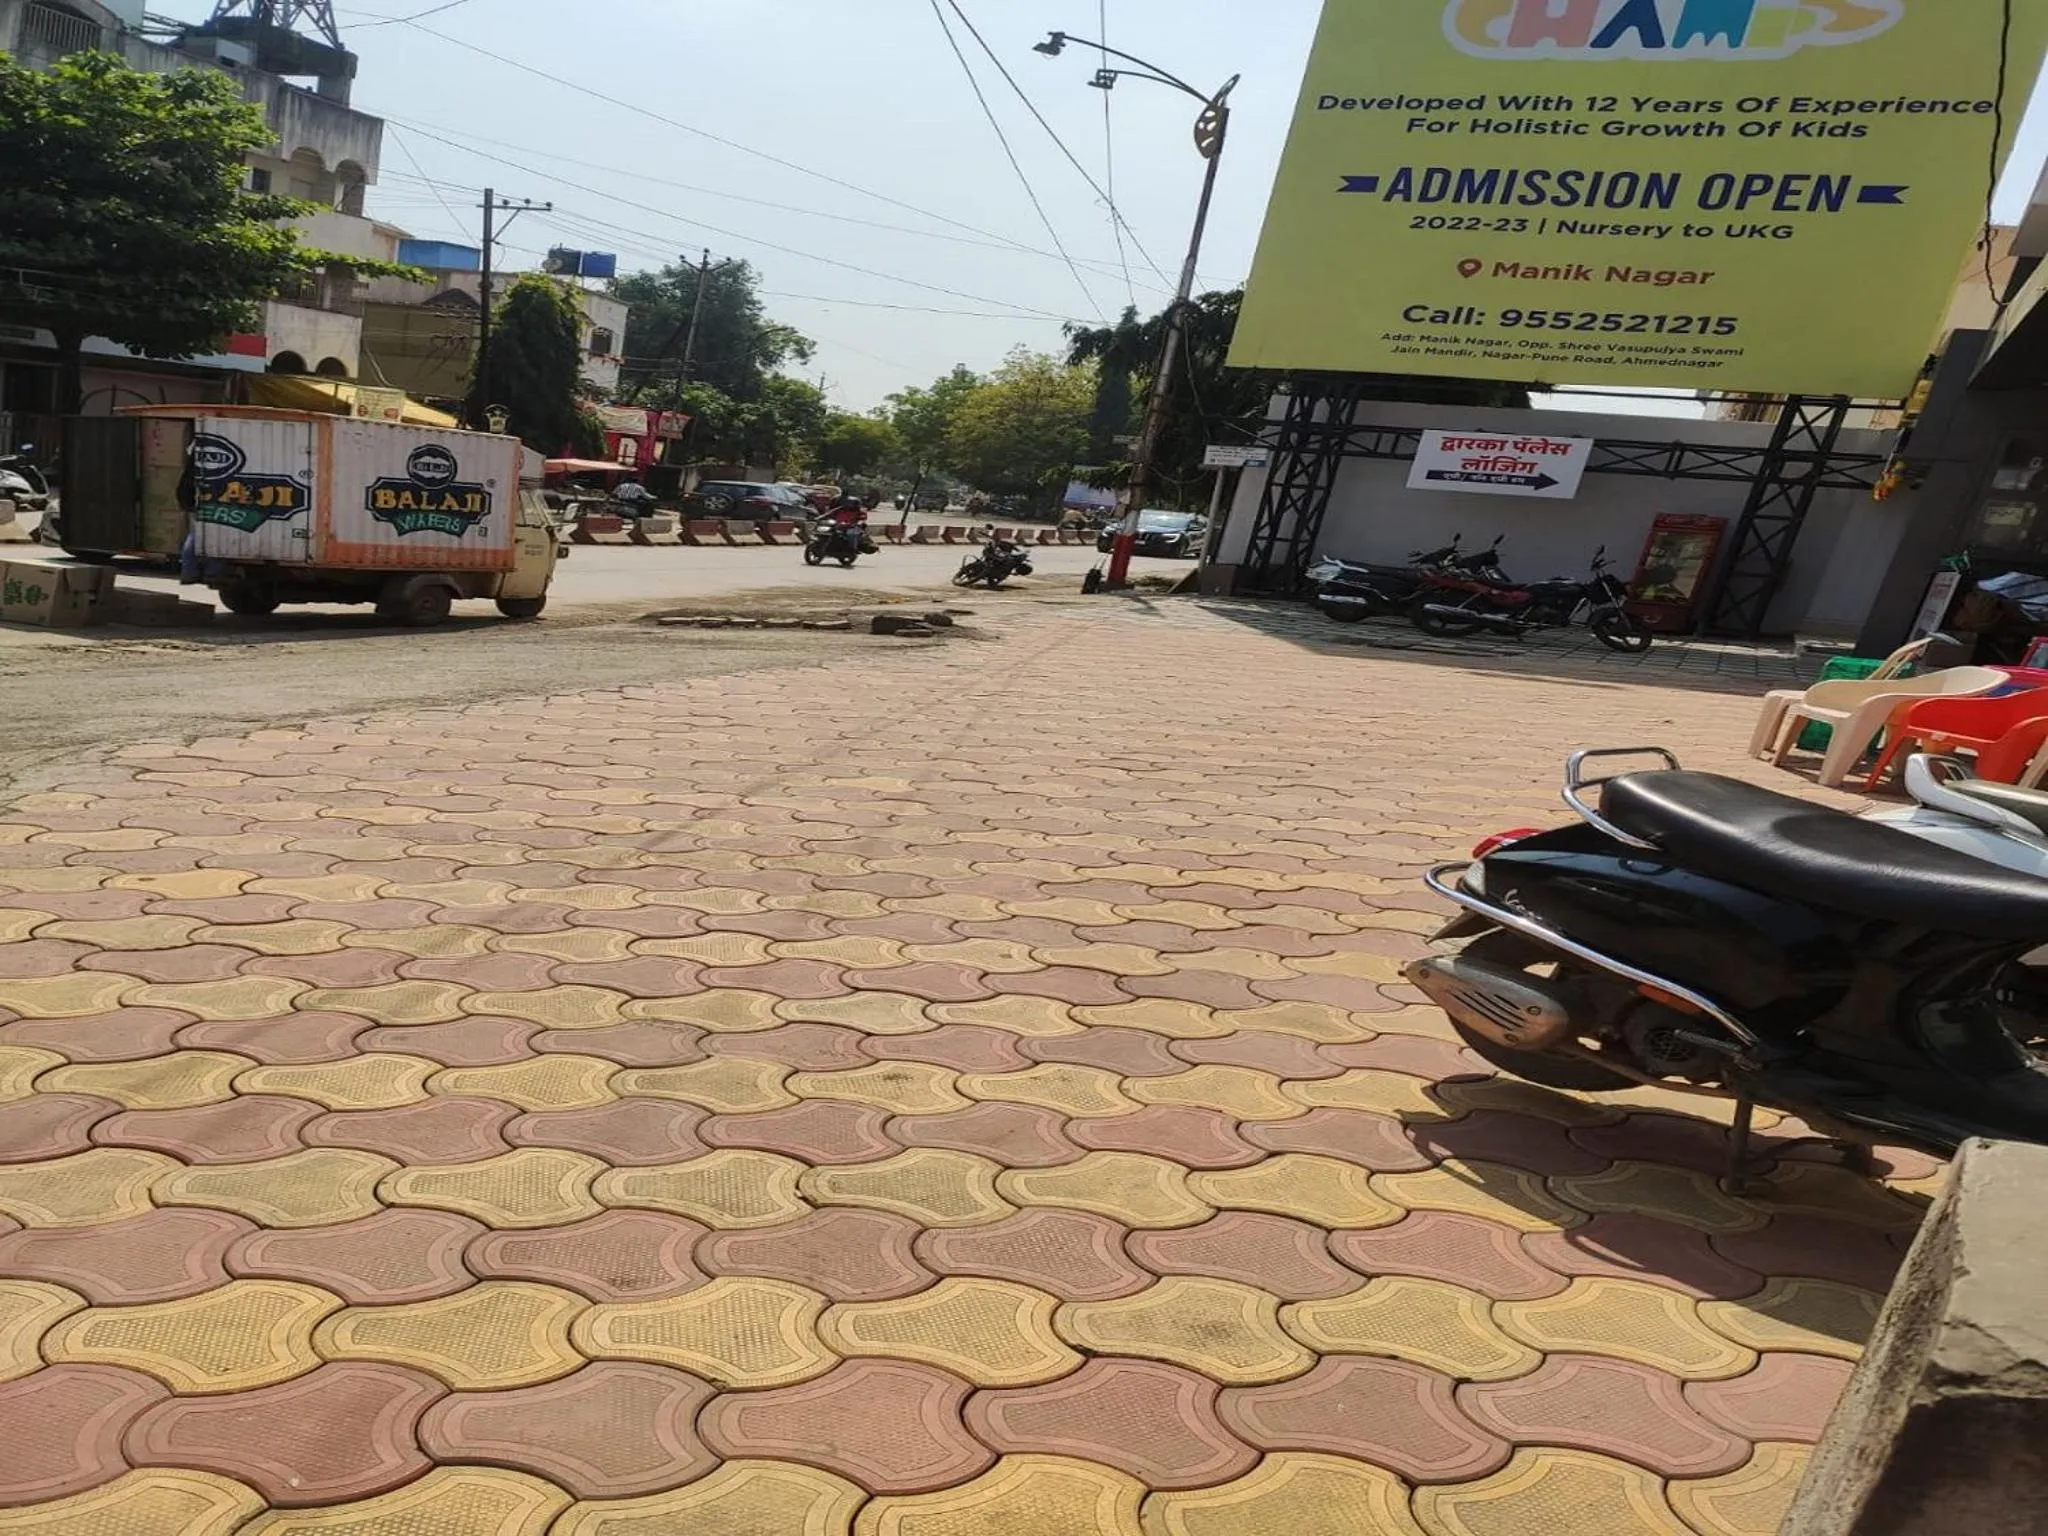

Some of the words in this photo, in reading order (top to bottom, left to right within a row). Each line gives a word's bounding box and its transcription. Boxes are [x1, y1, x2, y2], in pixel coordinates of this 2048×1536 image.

[1317, 95, 1486, 112] Developed
[1498, 95, 1574, 112] With
[1586, 97, 1617, 112] 12
[1631, 97, 1723, 113] Years
[1736, 97, 1780, 113] Of
[1789, 97, 1994, 116] Experience
[1406, 118, 1459, 134] For
[1469, 118, 1590, 136] Holistic
[1601, 119, 1726, 138] Growth
[1738, 121, 1782, 138] Of
[1790, 121, 1868, 138] Kids
[1382, 167, 1681, 208] ADMISSION
[1697, 174, 1851, 213] OPEN
[1409, 215, 1529, 234] 2022-23
[1555, 219, 1673, 239] Nursery
[1682, 222, 1714, 239] to
[1725, 223, 1795, 240] UKG
[1491, 261, 1594, 283] Manik
[1604, 266, 1716, 287] Nagar
[1403, 305, 1486, 326] Call:
[1500, 309, 1738, 336] 9552521215
[1381, 332, 1416, 342] Add:
[1419, 335, 1462, 345] Manik
[1465, 337, 1513, 349] Nagar,
[1518, 340, 1553, 350] Opp.
[1559, 341, 1602, 352] Shree
[1691, 345, 1744, 356] Swami
[1391, 345, 1422, 354] Jain
[1424, 347, 1478, 358] Mandir,
[1482, 350, 1569, 362] Nagar-Pune
[1572, 354, 1617, 366] Road,
[1621, 356, 1725, 368] Ahmednagar
[1441, 436, 1509, 452] द्वारका
[1513, 437, 1572, 456] पॅलेस
[1461, 456, 1539, 474] लॉजिंग
[374, 488, 482, 512] BALAJI
